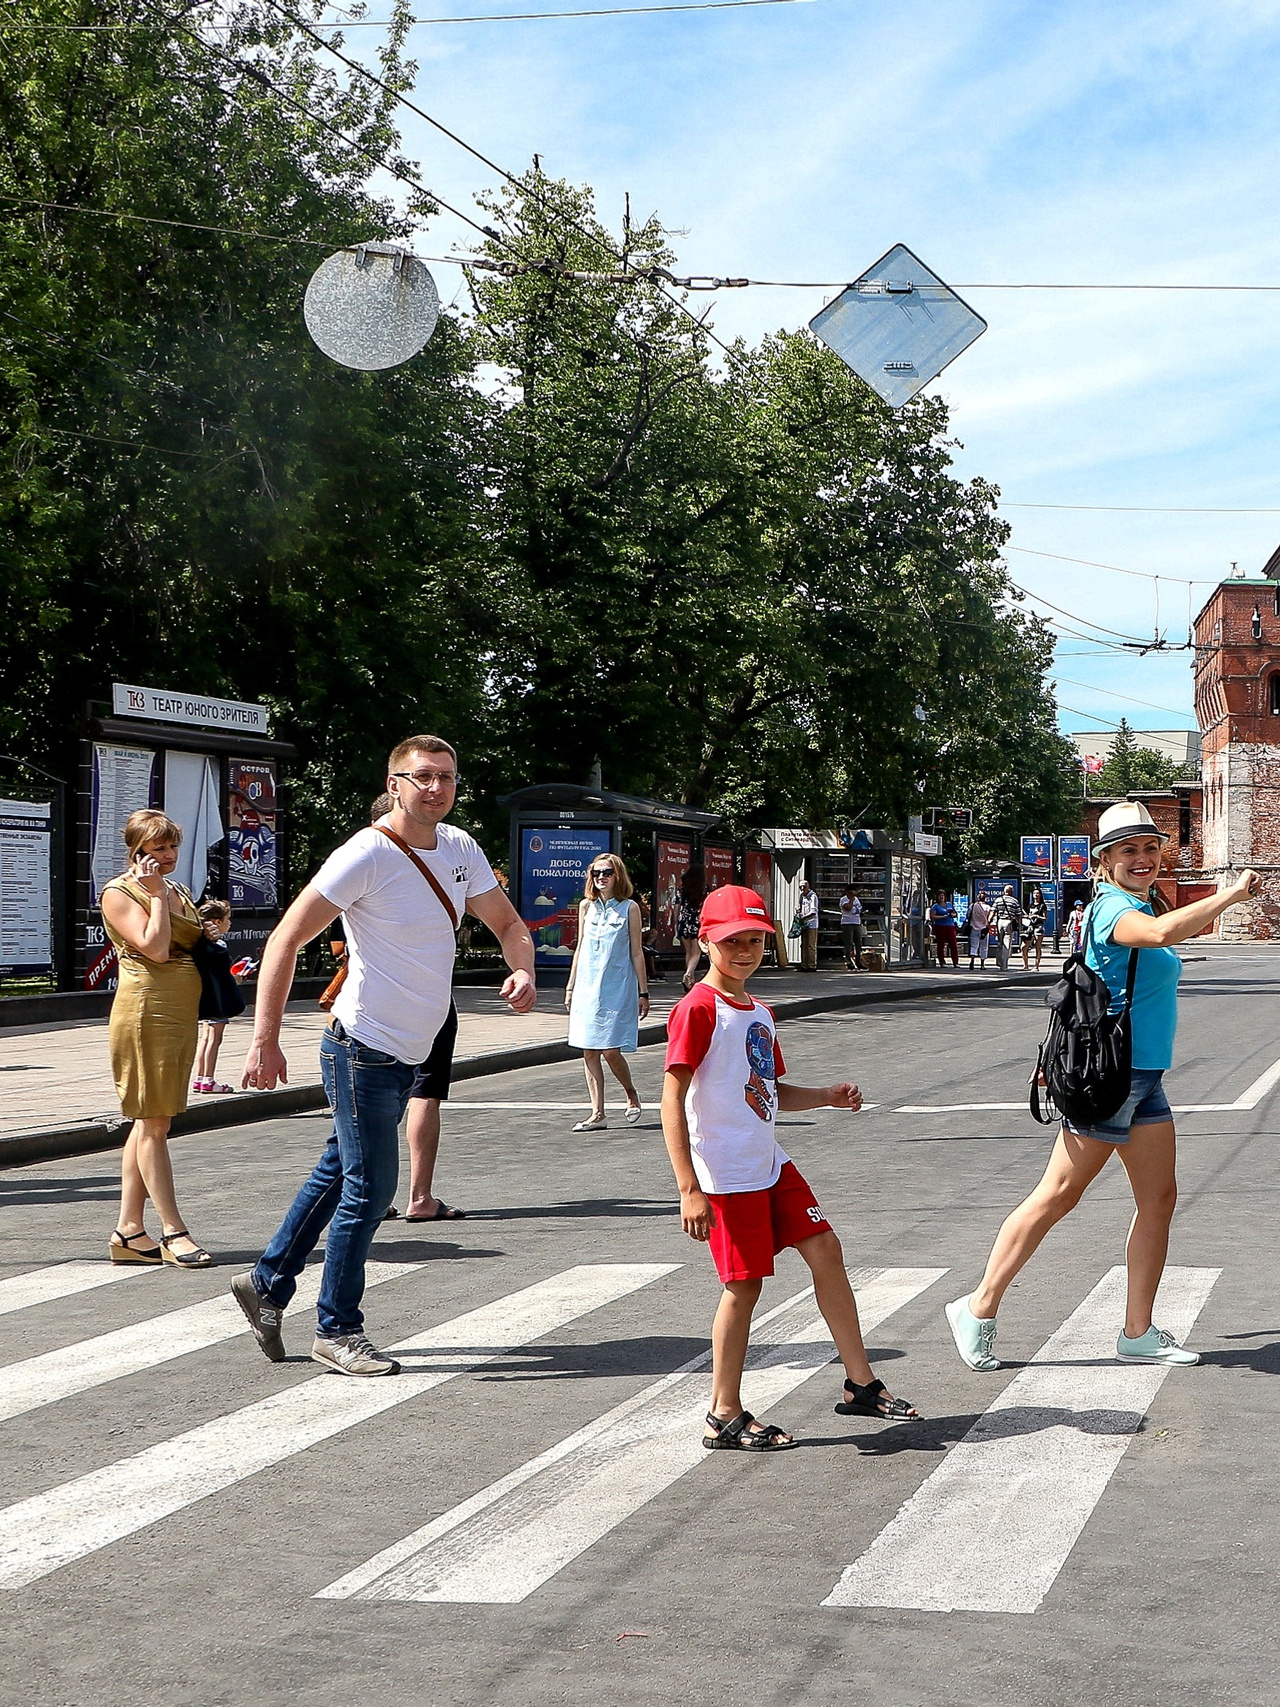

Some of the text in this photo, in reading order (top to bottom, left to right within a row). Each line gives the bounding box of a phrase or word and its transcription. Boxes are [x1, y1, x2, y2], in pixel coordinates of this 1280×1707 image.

[152, 697, 182, 714] ТЕАТР
[185, 701, 219, 720] ЮНОГО
[221, 708, 259, 725] ЗРИТЕЛЯ
[240, 765, 270, 773] ОСТРОВ
[549, 859, 582, 868] ДОБРО
